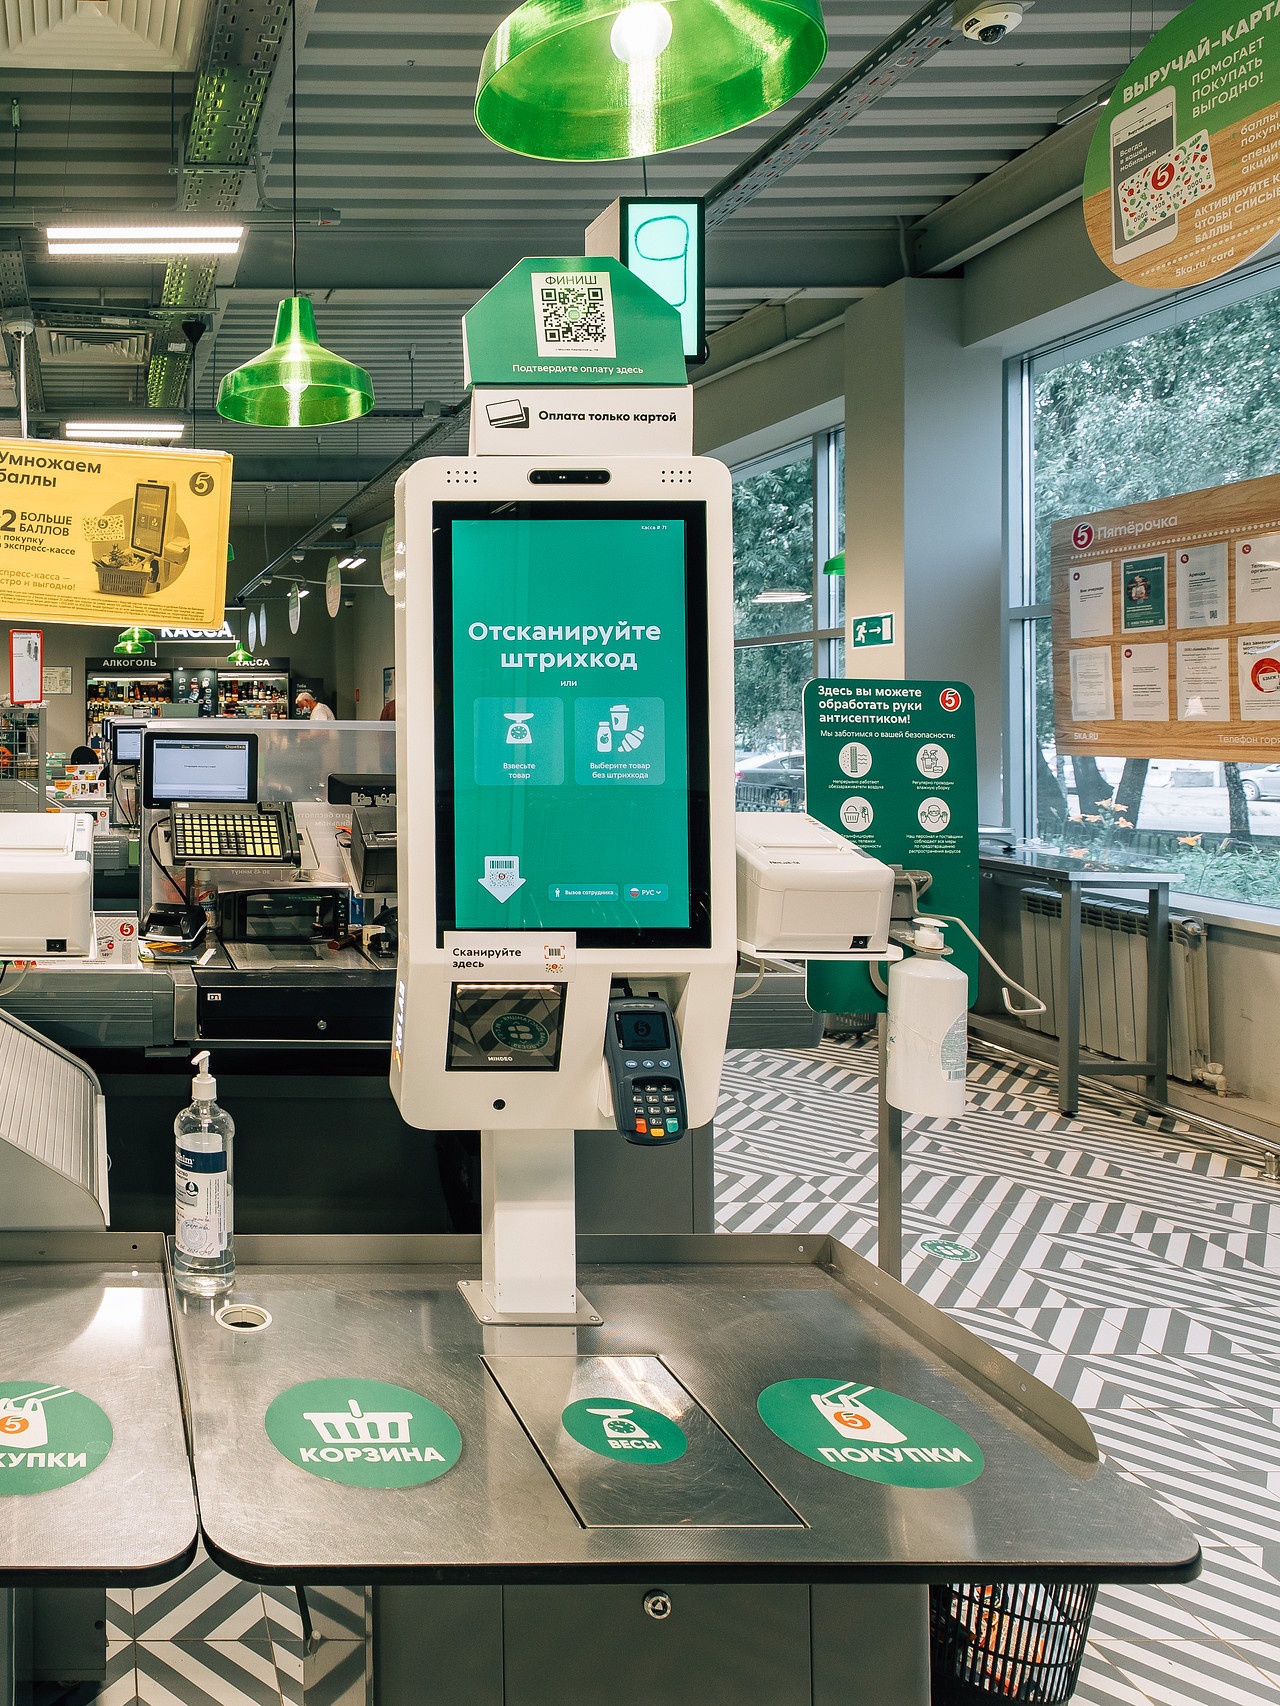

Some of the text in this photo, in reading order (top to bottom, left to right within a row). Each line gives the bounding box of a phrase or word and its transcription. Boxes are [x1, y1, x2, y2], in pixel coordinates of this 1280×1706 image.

[1192, 36, 1265, 86] ПОМОГАЕТ
[1192, 57, 1263, 102] ПОКУПАТЬ
[1192, 71, 1265, 119] ВЫГОДНО!
[1240, 110, 1279, 135] баллы
[1120, 141, 1143, 157] Всегда
[1241, 154, 1279, 175] акции
[1194, 178, 1270, 218] АКТИВИРУЙТЕ
[1194, 208, 1232, 231] ЧТОБЫ
[1195, 221, 1233, 244] БАЛЛЫ
[1175, 247, 1235, 278] 5ka.ru/card
[545, 275, 597, 286] ФИНИШ
[512, 364, 644, 375] Подтвердите оплату здесь
[538, 411, 677, 423] Оплата только картой
[20, 512, 72, 525] БОЛЬШЕ
[19, 523, 70, 536] БАЛЛОВ
[1097, 515, 1178, 540] Пятёрочка
[4, 535, 44, 545] покупку
[4, 543, 76, 555] экспресс-кассе
[32, 581, 76, 590] выгодно!
[468, 620, 661, 645] Отсканируйте
[103, 659, 157, 667] АЛКОГОЛЬ
[235, 659, 270, 667] КАССА
[501, 652, 638, 673] штрихкод
[818, 685, 922, 697] Здесь вы можете
[818, 698, 922, 713] обработать руки
[819, 714, 911, 724] антисептиком!
[834, 730, 873, 738] заботимся
[881, 731, 904, 739] вашей
[905, 731, 956, 739] безопасности:
[1217, 734, 1258, 745] Телефон
[503, 762, 536, 770] Взвесьте
[590, 762, 651, 770] Выберите товар
[508, 772, 531, 780] товар
[592, 771, 649, 780] без штрихкода
[452, 947, 522, 959] Сканируйте
[452, 959, 485, 969] здесь
[608, 1439, 661, 1451] ВЕСЫ
[300, 1447, 447, 1463] КОРЗИНА
[818, 1447, 973, 1465] ПОКУПКИ
